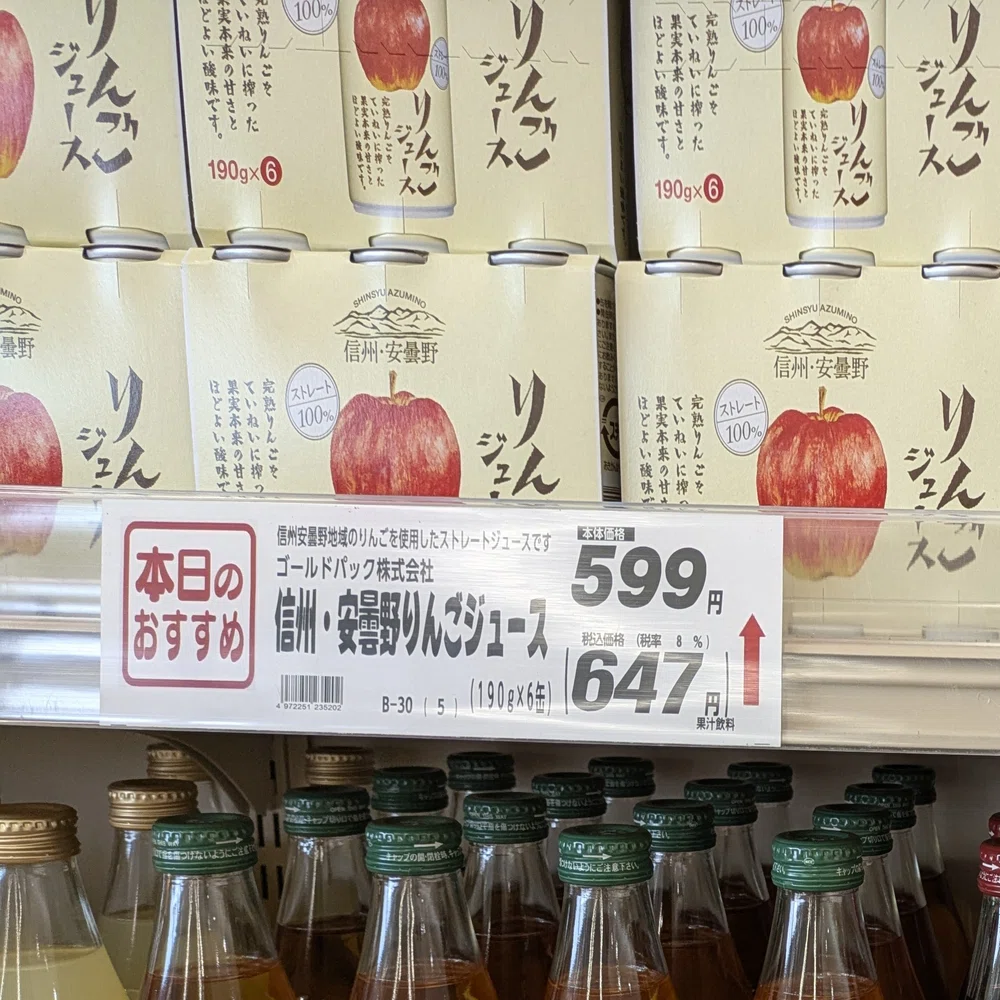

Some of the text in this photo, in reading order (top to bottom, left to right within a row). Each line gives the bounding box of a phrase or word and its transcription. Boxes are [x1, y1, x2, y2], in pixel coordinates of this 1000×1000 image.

[294, 0, 333, 21] 100%
[742, 17, 778, 40] 100%
[947, 3, 990, 178] りんご
[50, 42, 91, 171] ジュース
[479, 54, 511, 171] ジュース
[915, 60, 949, 177] ジュース
[291, 380, 332, 401] ストレート
[298, 404, 334, 428] 100%
[719, 396, 761, 418] ストレート
[725, 418, 762, 444] 100%
[277, 525, 552, 552] 信州安曇野地域のりんごを使用したストレートジュースです
[582, 526, 625, 541] 本体価格
[135, 545, 244, 603] 本日の
[276, 555, 434, 583] ゴールドパック株式会社
[134, 608, 244, 662] おすすめ
[274, 586, 549, 661] 信州・安曇野りんごジュース
[581, 631, 625, 648] 税込価格
[284, 702, 342, 712] 972251 235202
[382, 695, 413, 715] B-30
[696, 716, 735, 731] 果汁飲料
